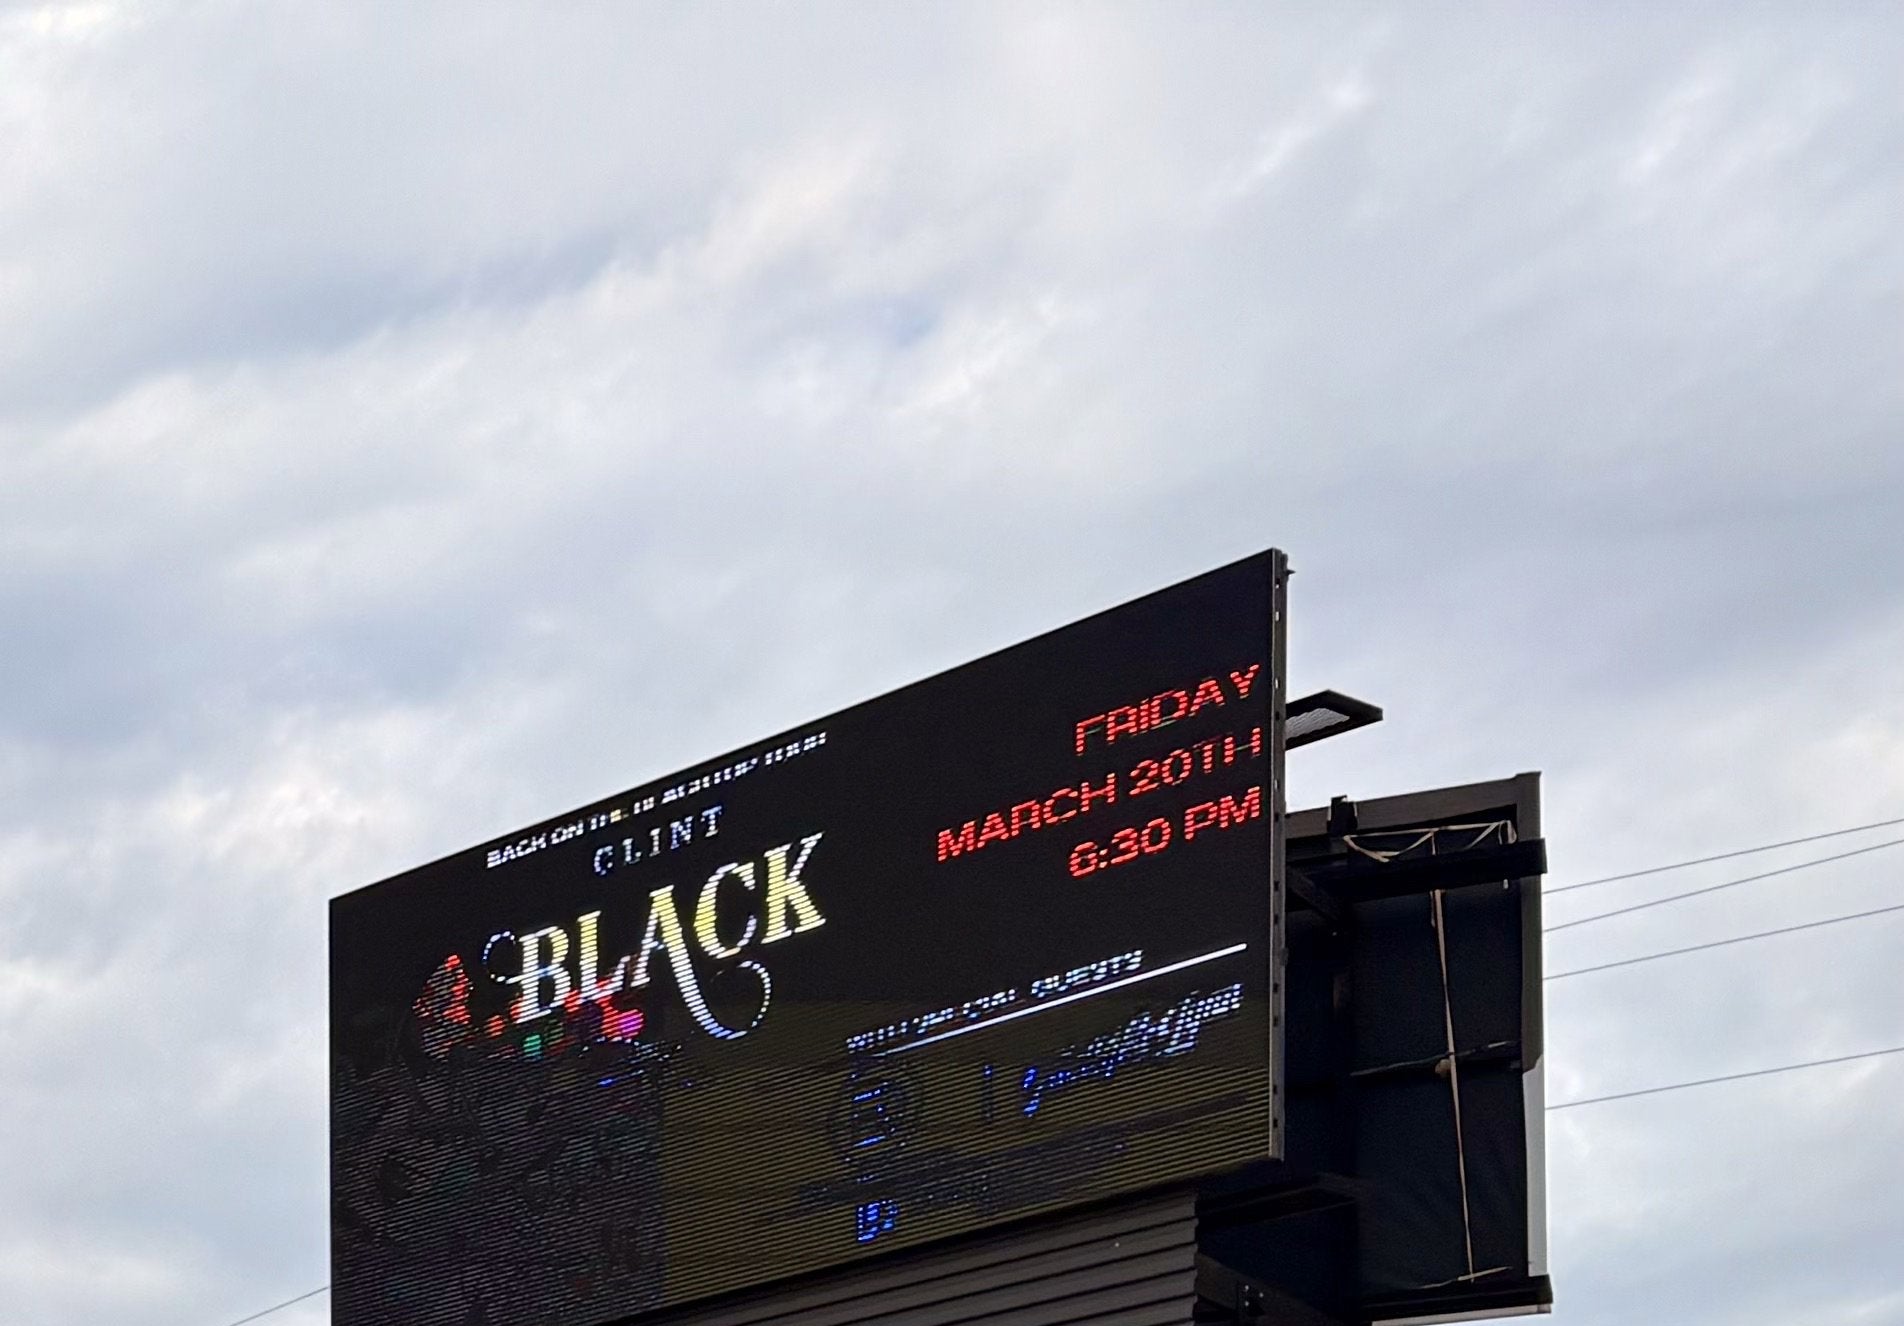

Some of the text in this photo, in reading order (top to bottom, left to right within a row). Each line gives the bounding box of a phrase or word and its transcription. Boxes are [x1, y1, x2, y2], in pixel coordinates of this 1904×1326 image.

[1075, 663, 1260, 757] FRIDAY
[593, 805, 723, 877] CLINT
[937, 727, 1262, 862] MARCH 20TH
[1068, 786, 1261, 878] 6:30 PM
[487, 832, 547, 869] BACK
[550, 821, 584, 846] ON
[483, 831, 827, 1041] BLACK
